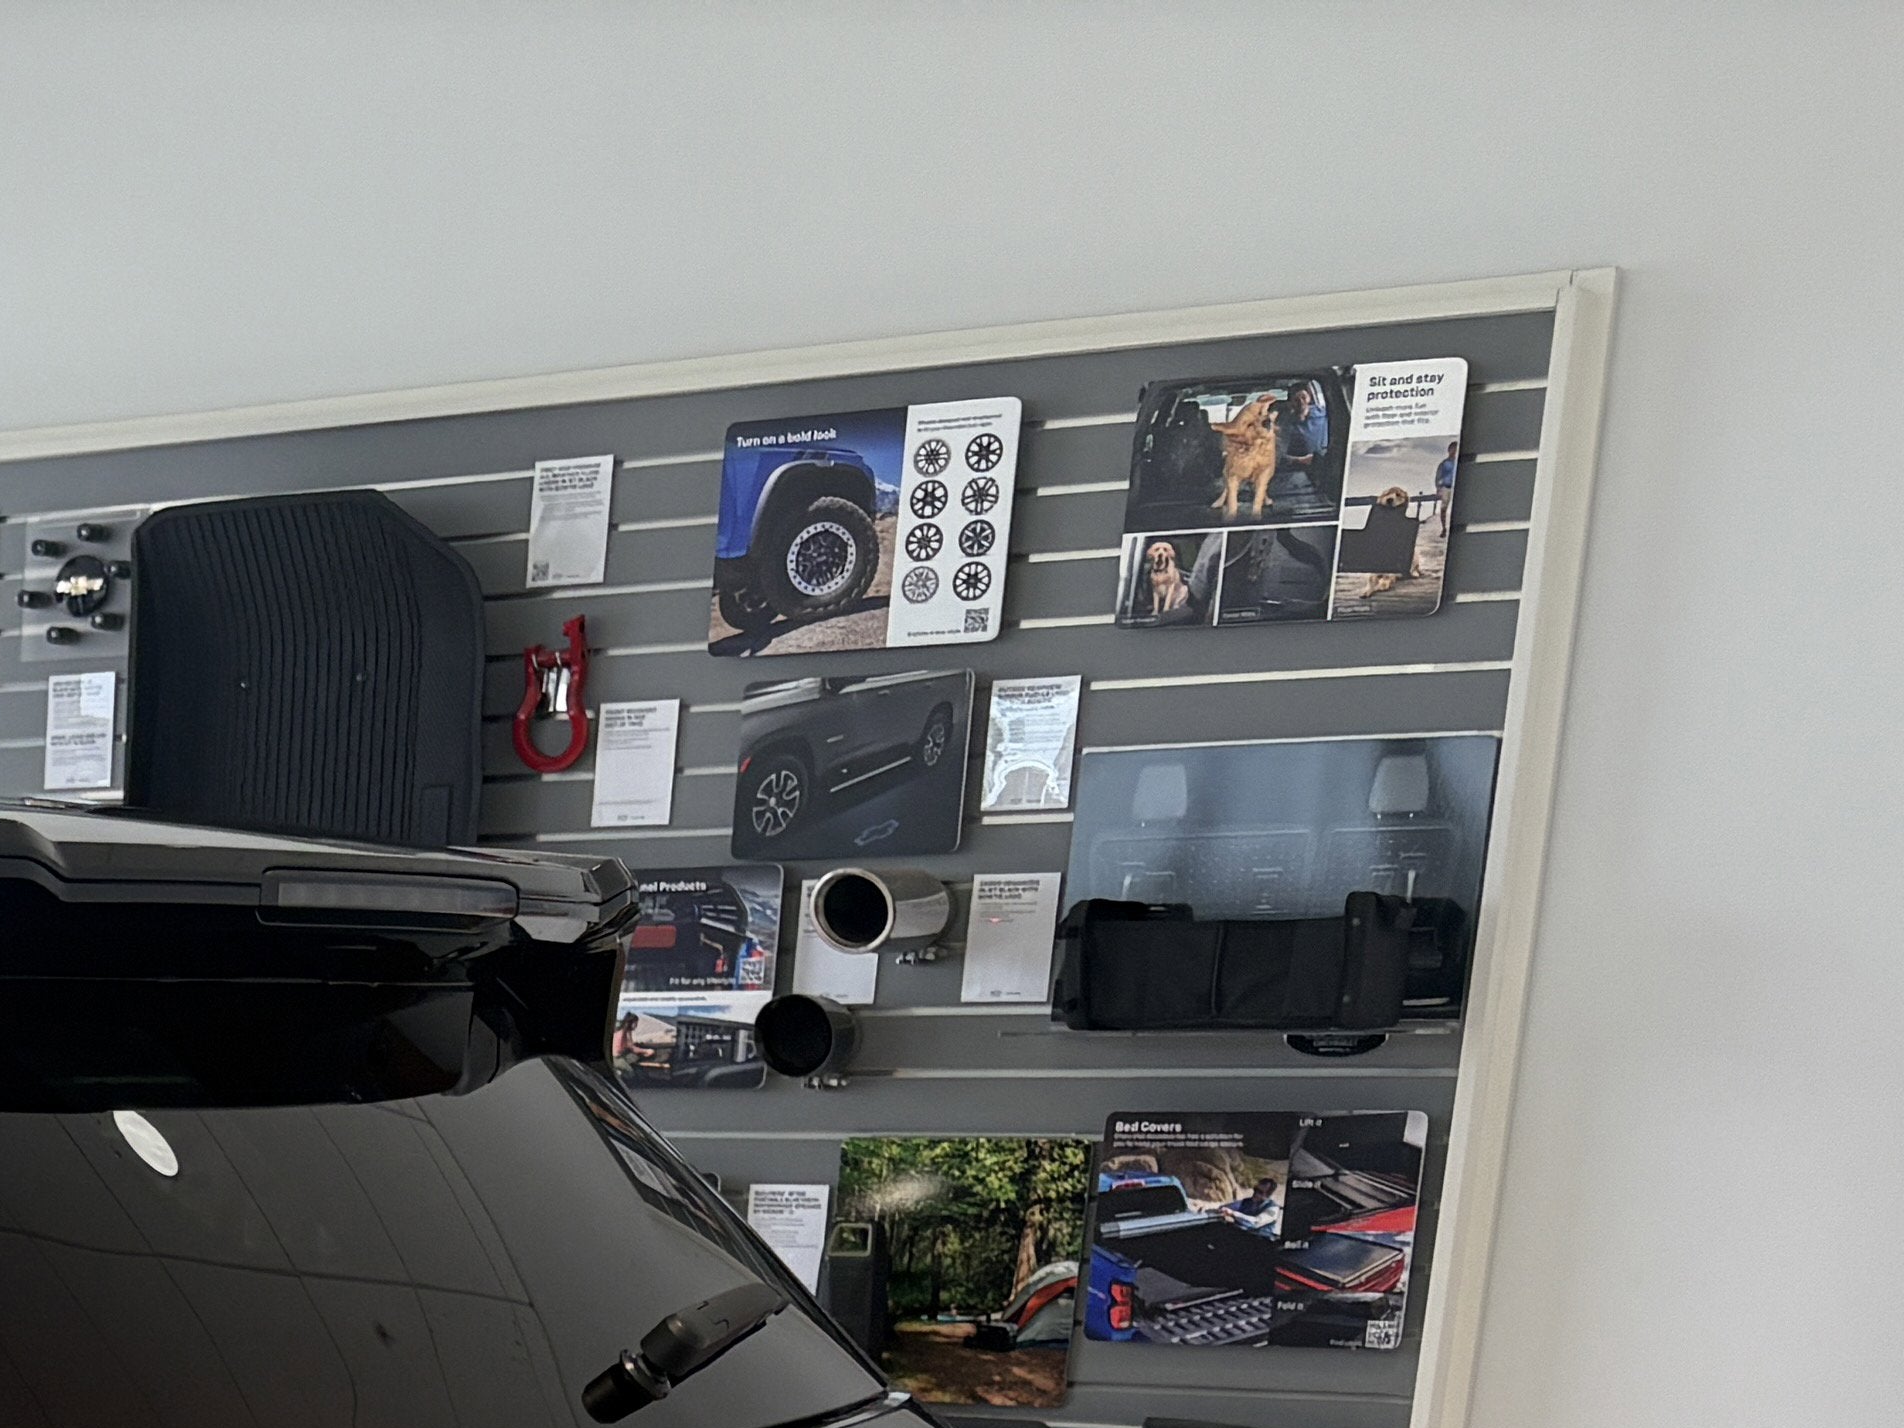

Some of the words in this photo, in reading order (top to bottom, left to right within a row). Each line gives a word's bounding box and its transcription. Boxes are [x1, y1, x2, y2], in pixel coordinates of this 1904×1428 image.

[1369, 376, 1386, 387] Sit
[1389, 373, 1413, 385] and
[1416, 372, 1445, 385] stay
[1367, 386, 1434, 402] protection
[736, 435, 761, 448] Turn
[762, 435, 776, 446] on
[787, 430, 812, 443] bold
[813, 428, 837, 440] look
[659, 881, 707, 892] Products
[1115, 1121, 1139, 1133] Bed
[1140, 1121, 1182, 1133] Covers
